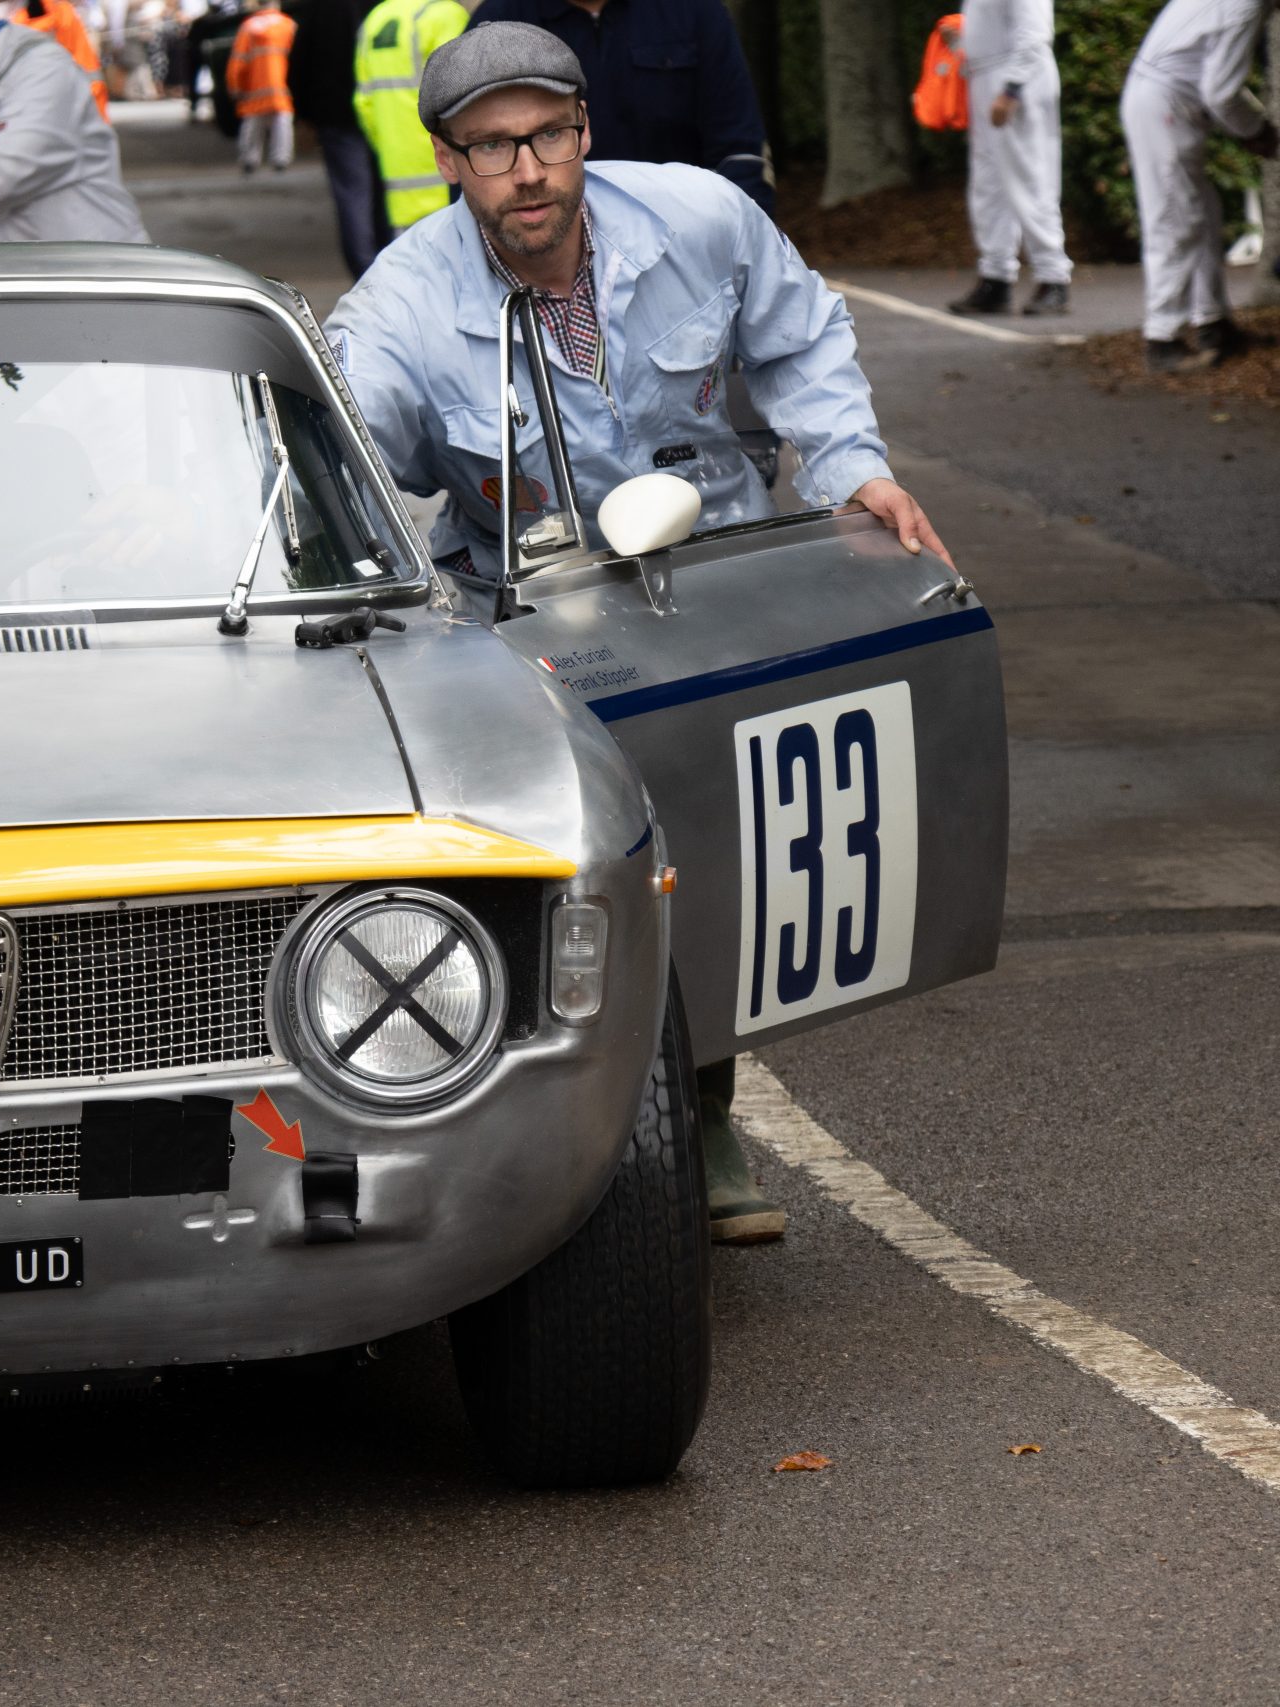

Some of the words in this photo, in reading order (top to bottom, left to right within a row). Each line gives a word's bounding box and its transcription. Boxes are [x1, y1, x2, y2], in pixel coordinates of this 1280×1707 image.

[550, 654, 579, 671] Alex
[572, 645, 616, 666] Furiani
[565, 673, 599, 693] Frank
[596, 665, 641, 688] Stippler
[749, 708, 881, 1019] 133
[16, 1247, 70, 1285] UD
